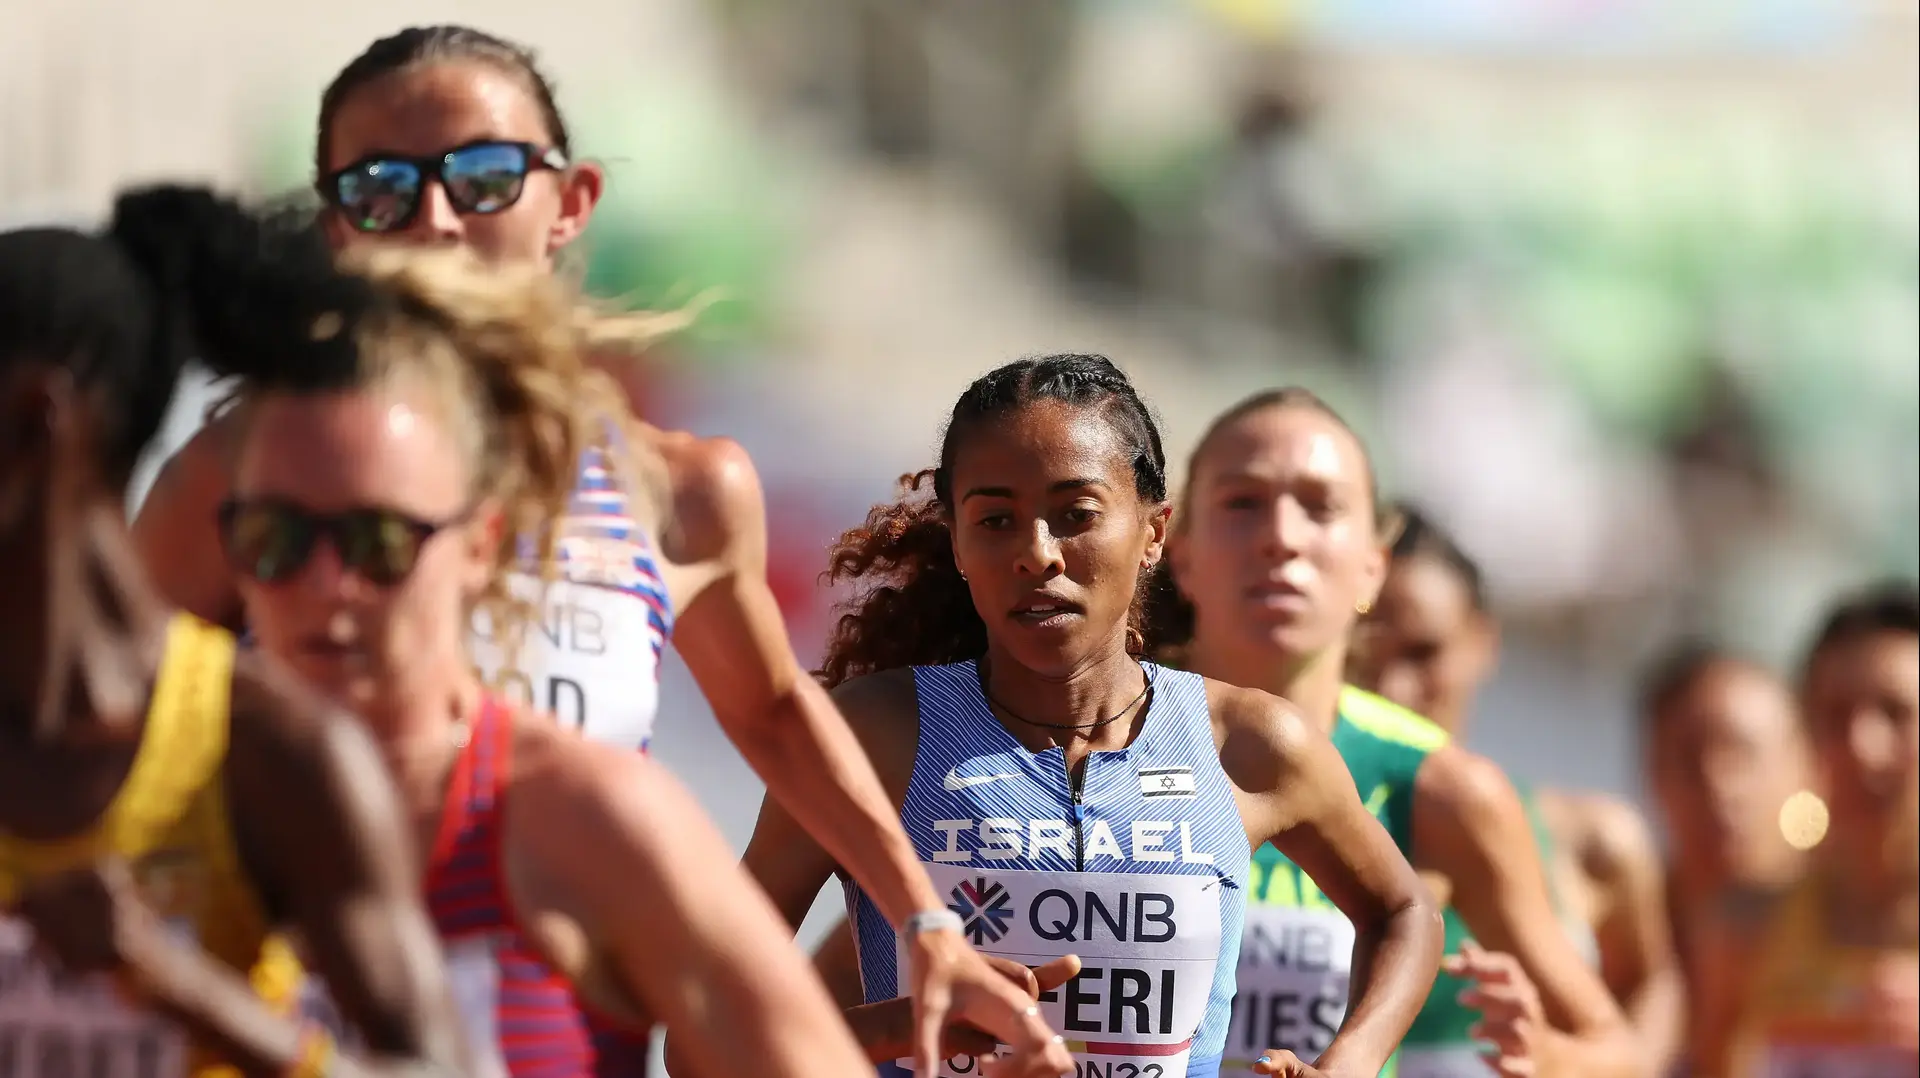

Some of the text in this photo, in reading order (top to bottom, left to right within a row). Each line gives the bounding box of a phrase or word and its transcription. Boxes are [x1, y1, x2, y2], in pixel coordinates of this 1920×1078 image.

[932, 817, 1214, 865] ISRAEL
[1028, 888, 1177, 944] QNB
[1248, 922, 1334, 974] NB
